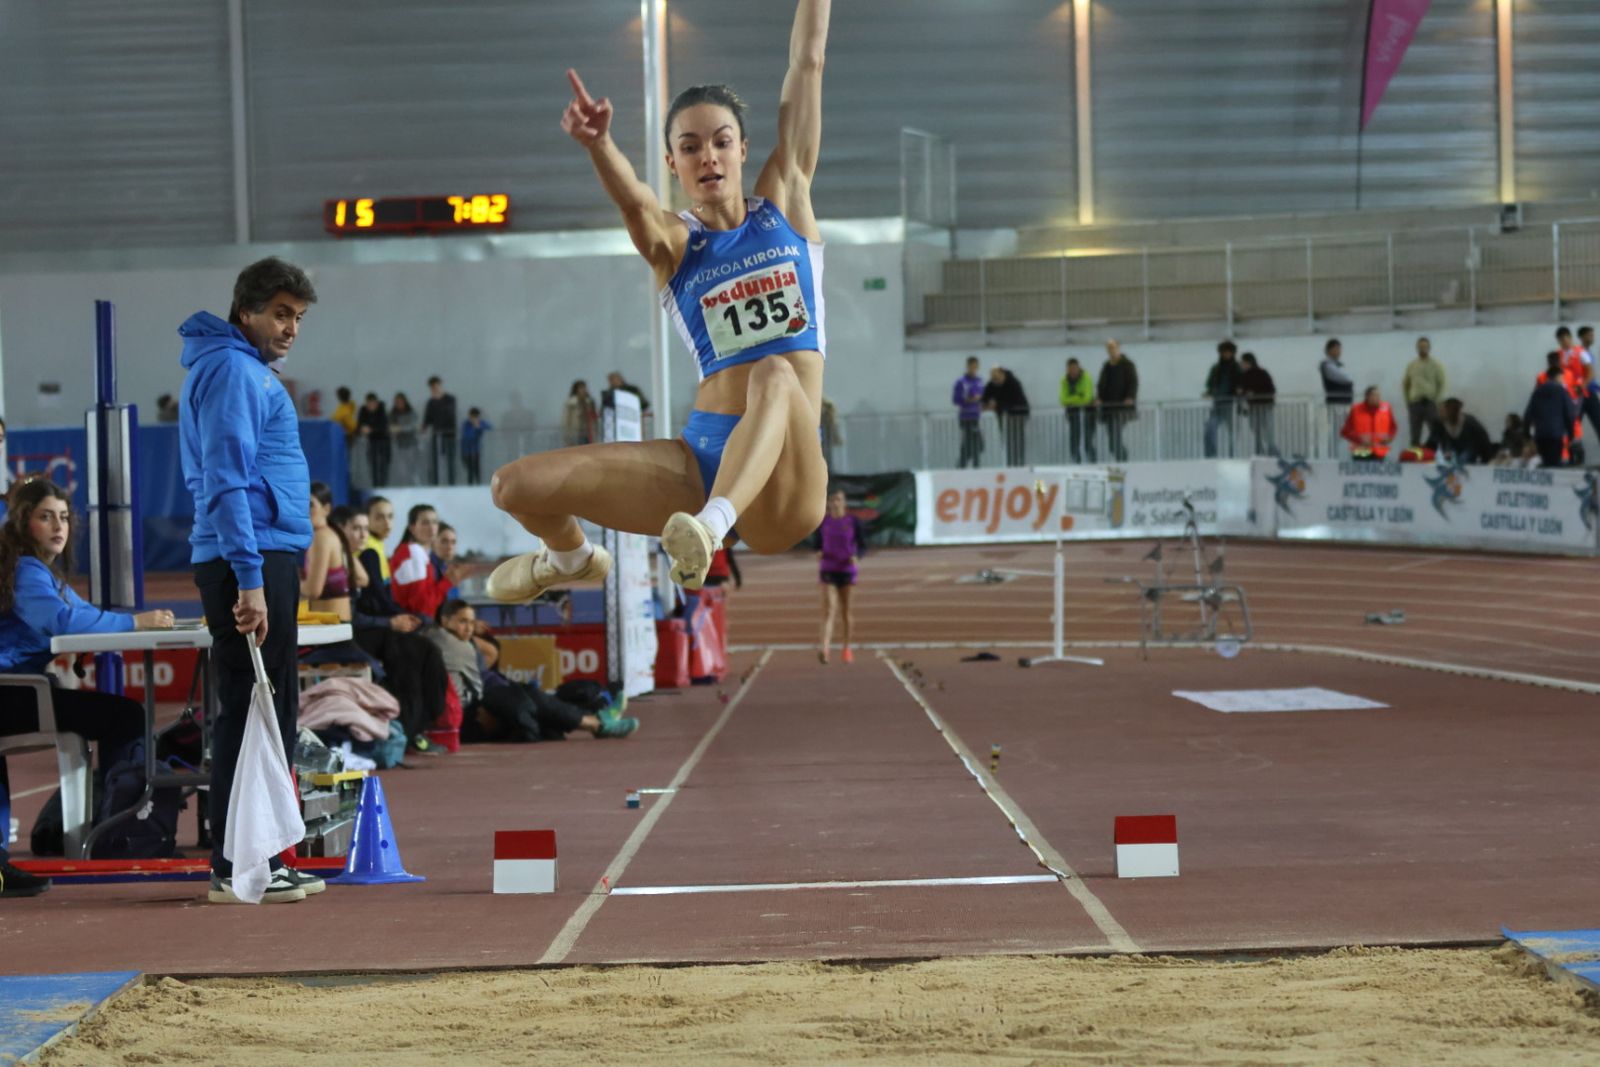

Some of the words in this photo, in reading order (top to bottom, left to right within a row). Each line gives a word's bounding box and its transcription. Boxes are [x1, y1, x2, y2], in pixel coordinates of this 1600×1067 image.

[743, 245, 800, 268] KIROLAK
[723, 291, 790, 336] 135
[1131, 486, 1217, 507] Ayuntamento
[1343, 483, 1399, 500] ATLETISMO
[1496, 491, 1549, 510] ATLETISMO
[1131, 509, 1147, 526] de
[1327, 505, 1376, 522] CASTILLA
[1481, 512, 1526, 531] CASTILLA
